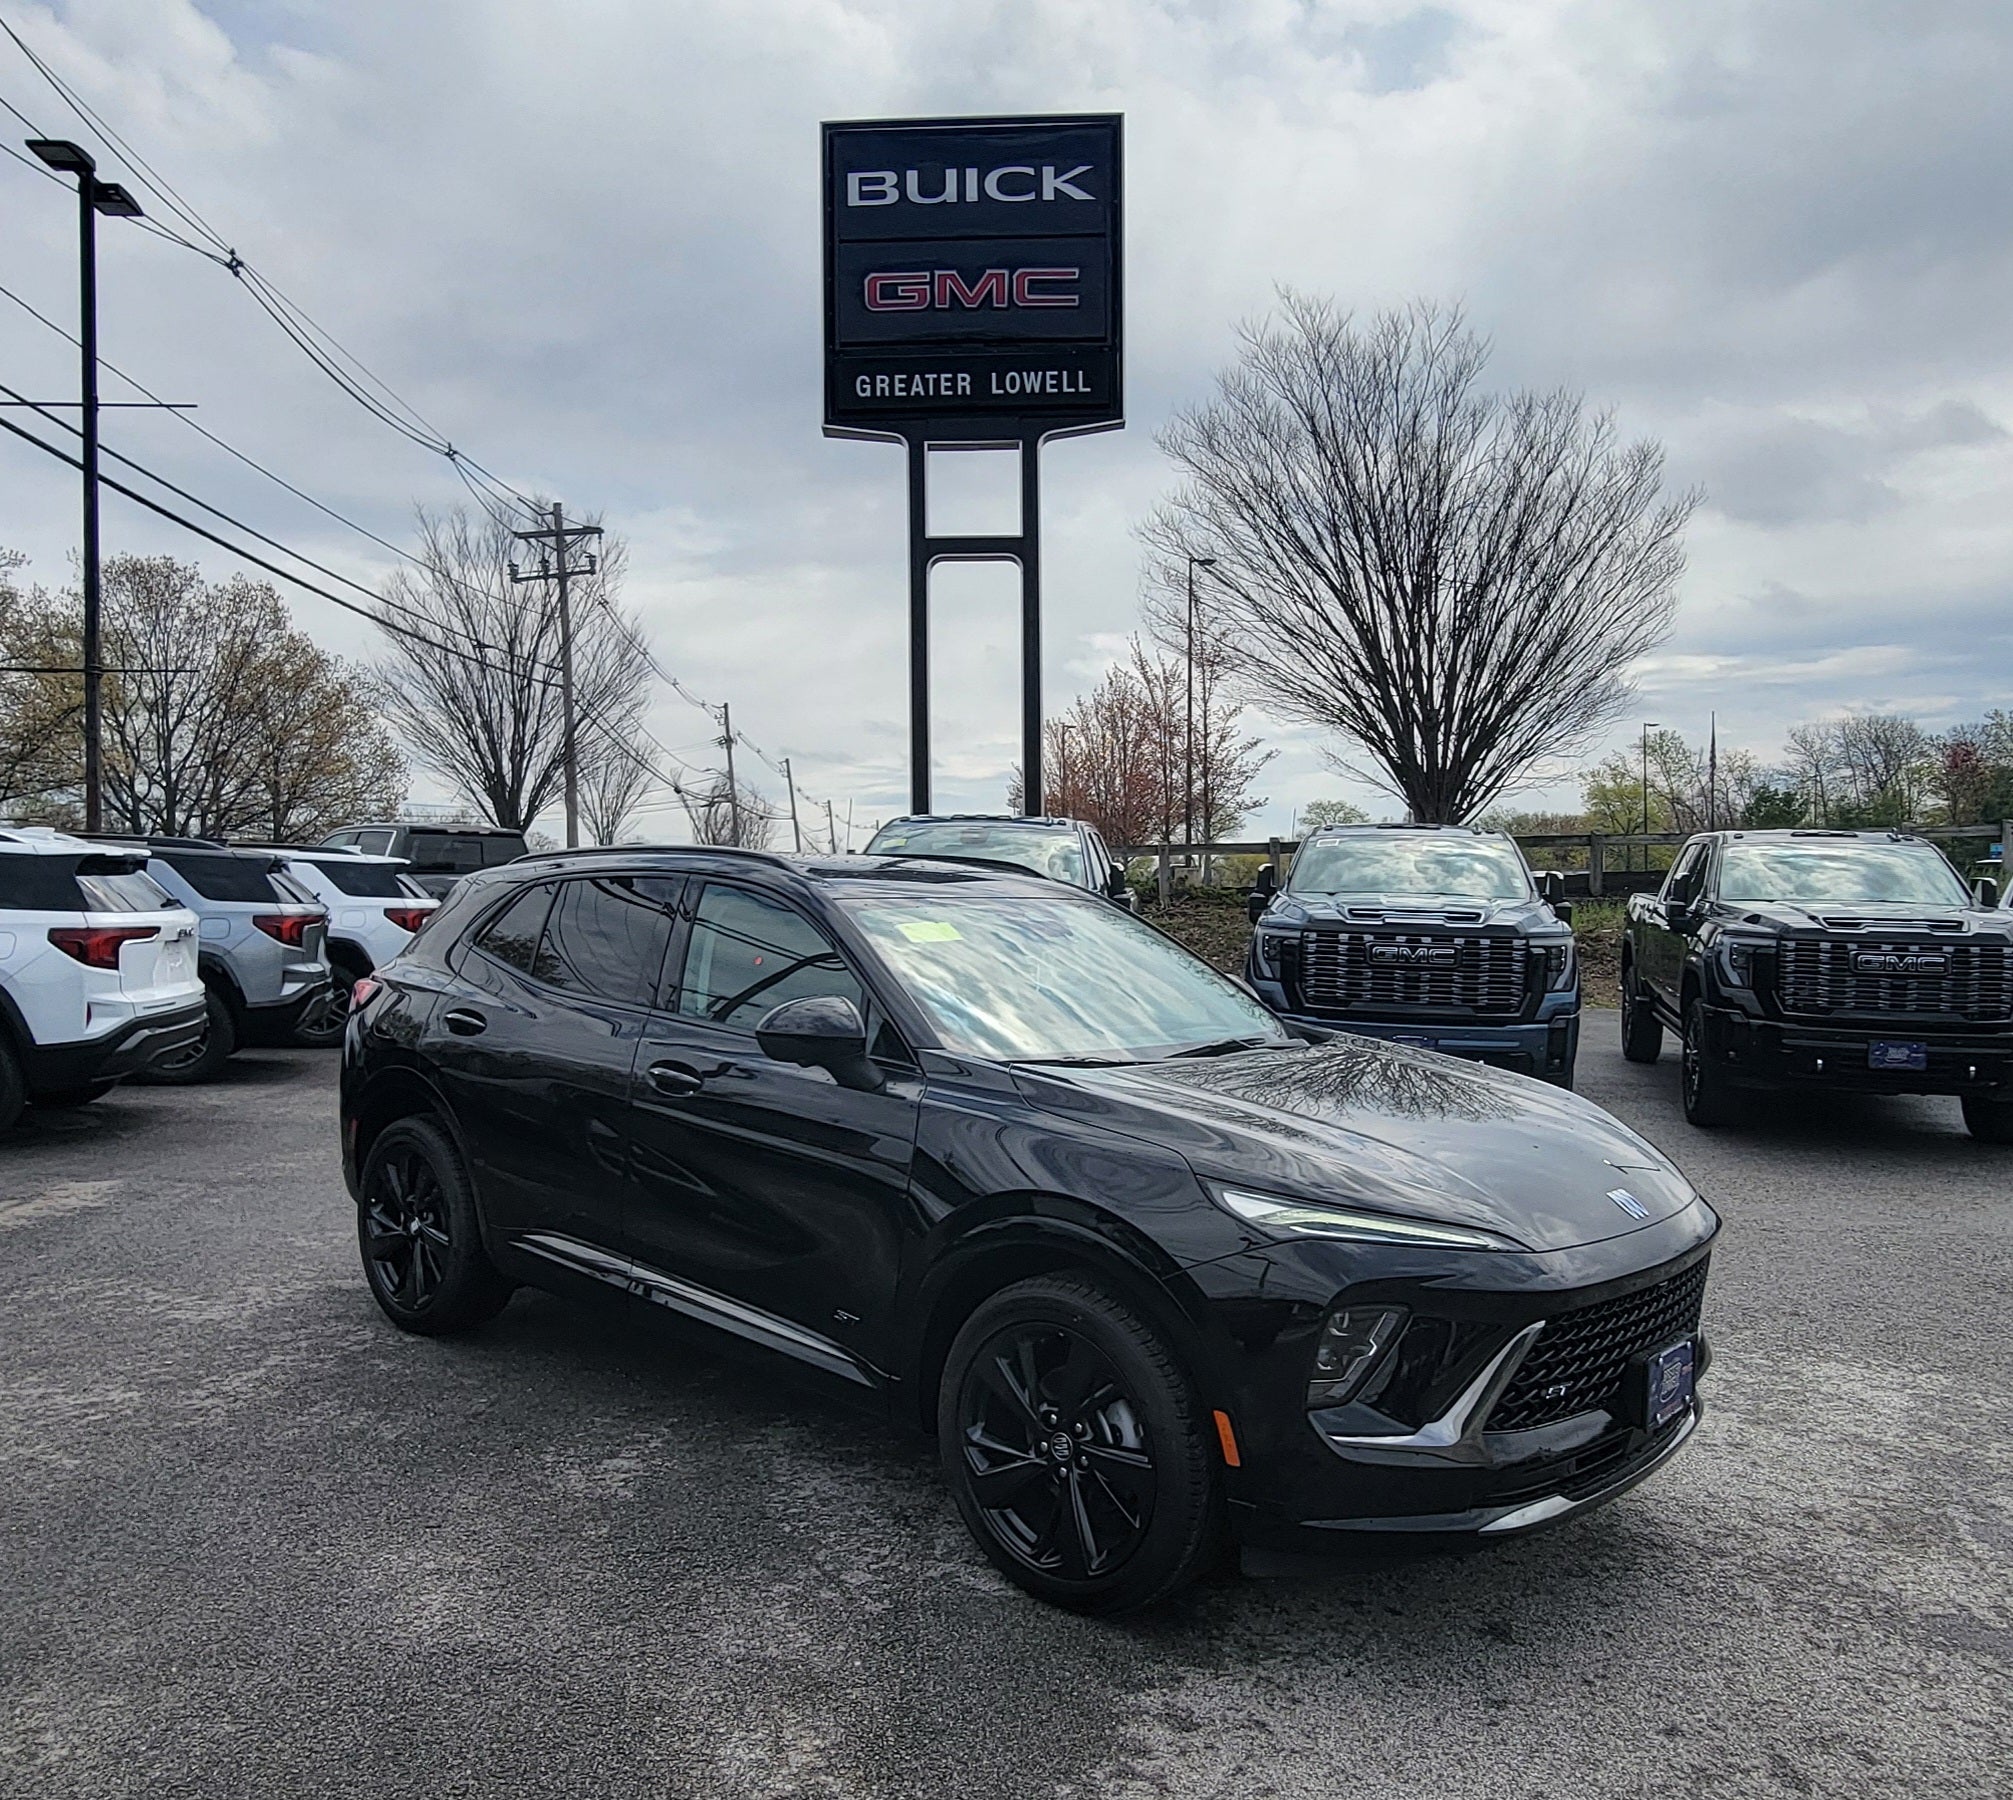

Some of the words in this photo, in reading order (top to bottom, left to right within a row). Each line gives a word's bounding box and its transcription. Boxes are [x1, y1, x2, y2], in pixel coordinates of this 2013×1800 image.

[847, 165, 1096, 206] BUICK
[864, 267, 1080, 311] GMC
[855, 373, 972, 397] GREATER
[991, 370, 1092, 394] LOWELL
[1372, 946, 1456, 964] GMC
[1857, 955, 1946, 972] GMC
